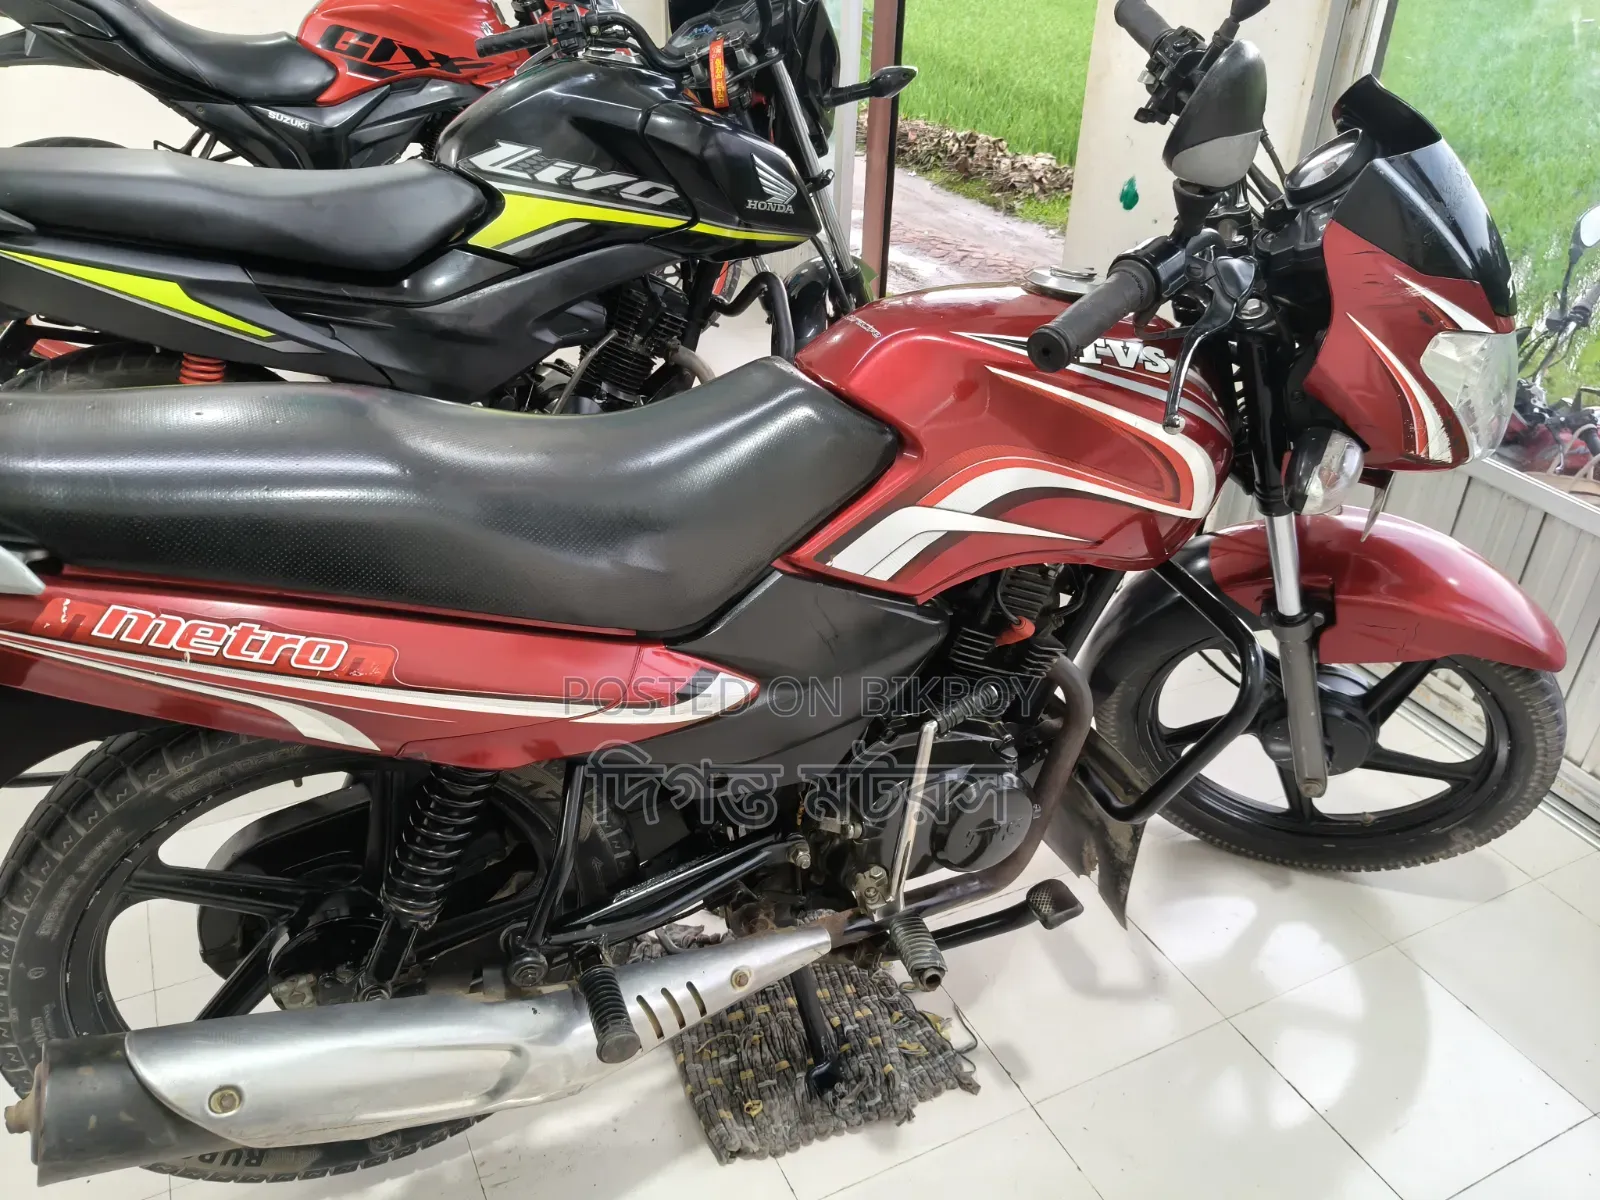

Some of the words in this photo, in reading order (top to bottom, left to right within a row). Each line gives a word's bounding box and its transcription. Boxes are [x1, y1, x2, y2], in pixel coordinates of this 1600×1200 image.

[268, 110, 309, 131] SUZUKI
[746, 199, 795, 214] HONDA
[1079, 338, 1171, 374] TVS
[91, 604, 349, 672] metro
